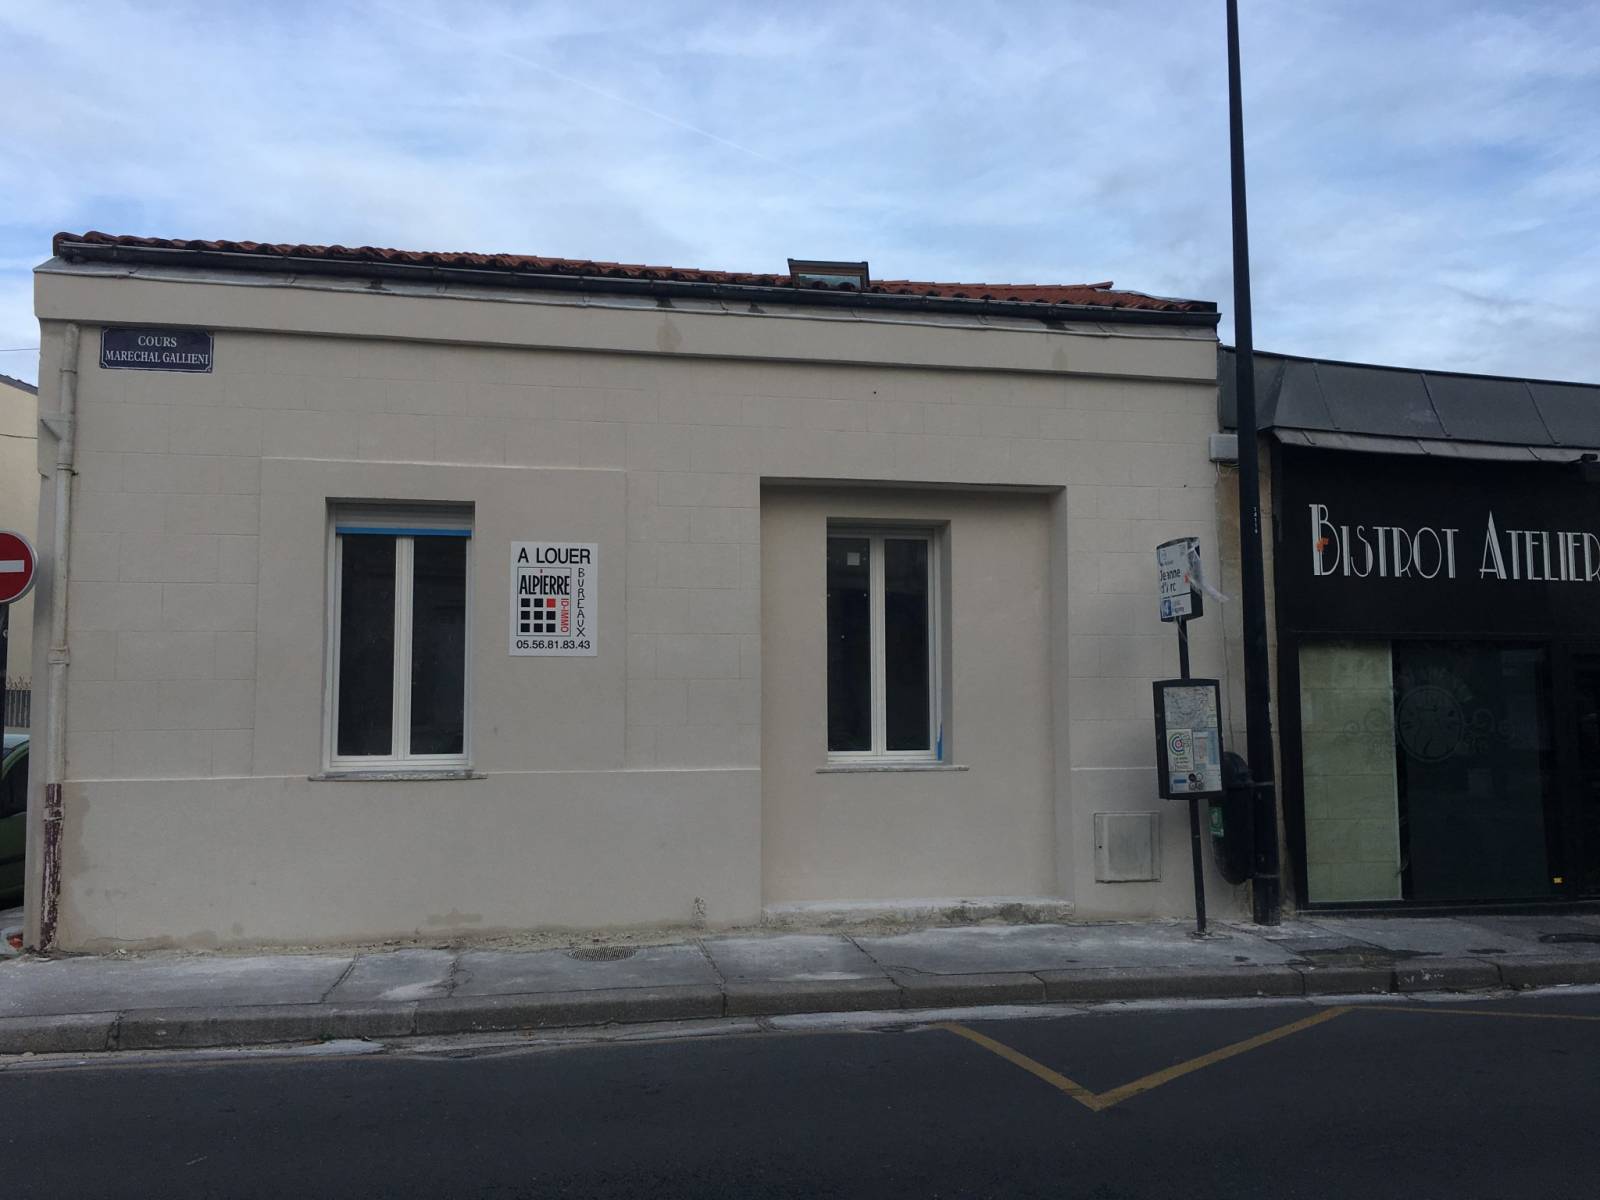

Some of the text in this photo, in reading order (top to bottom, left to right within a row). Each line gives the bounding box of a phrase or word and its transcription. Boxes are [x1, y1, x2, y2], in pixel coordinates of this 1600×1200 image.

[138, 336, 177, 347] COURS
[105, 350, 209, 364] MARECHAL GALLIENI
[1309, 503, 1459, 579] BISTROT
[517, 547, 591, 564] A LOUER
[576, 567, 586, 637] BUREAUX
[516, 640, 591, 649] 05.56.81.83.43
